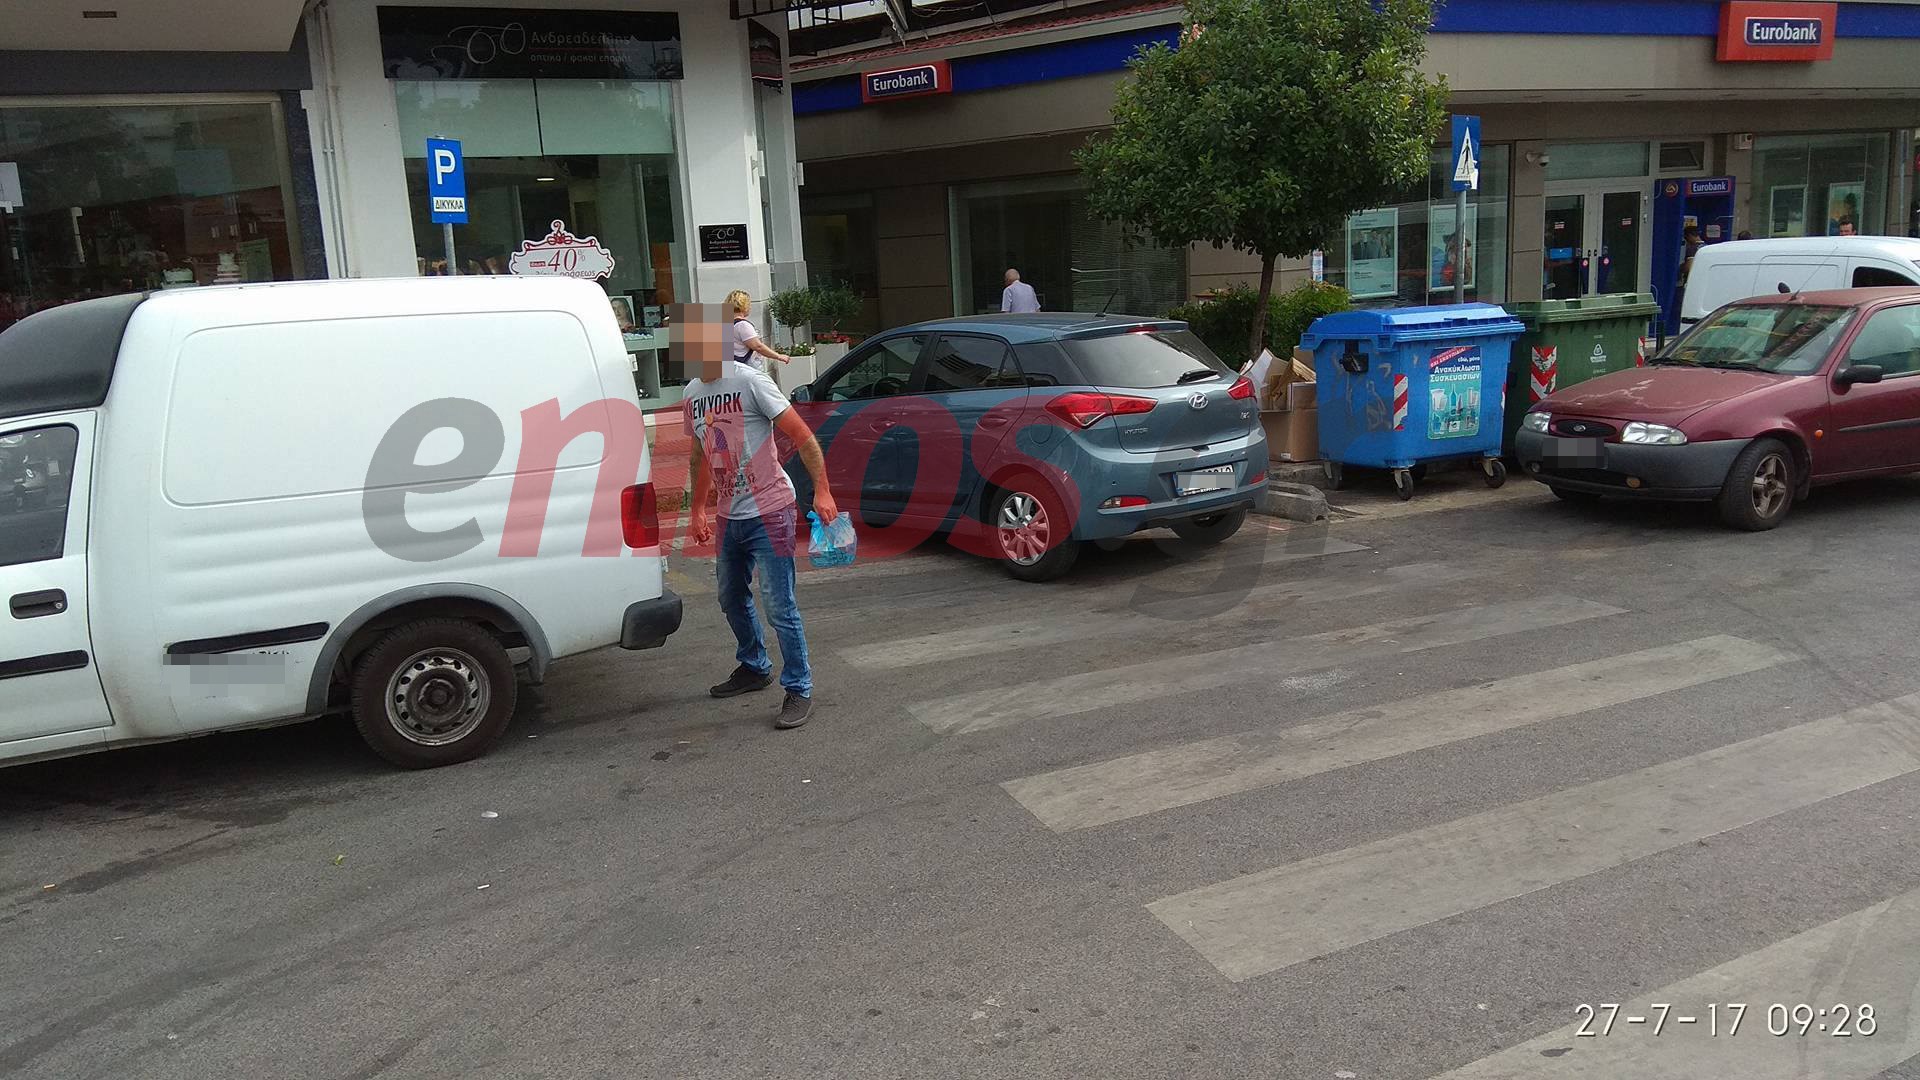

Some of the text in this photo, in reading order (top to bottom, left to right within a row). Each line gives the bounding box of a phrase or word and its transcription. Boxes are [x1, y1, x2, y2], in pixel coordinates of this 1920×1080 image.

[1752, 22, 1817, 40] Eurobank
[873, 71, 928, 91] Eurobank
[434, 149, 456, 185] P
[1693, 182, 1726, 192] Eurobank
[436, 200, 464, 209] ΔΙΚΥΚΛΑ
[1434, 364, 1480, 373] Ανακύκλωση
[708, 392, 742, 415] YORK
